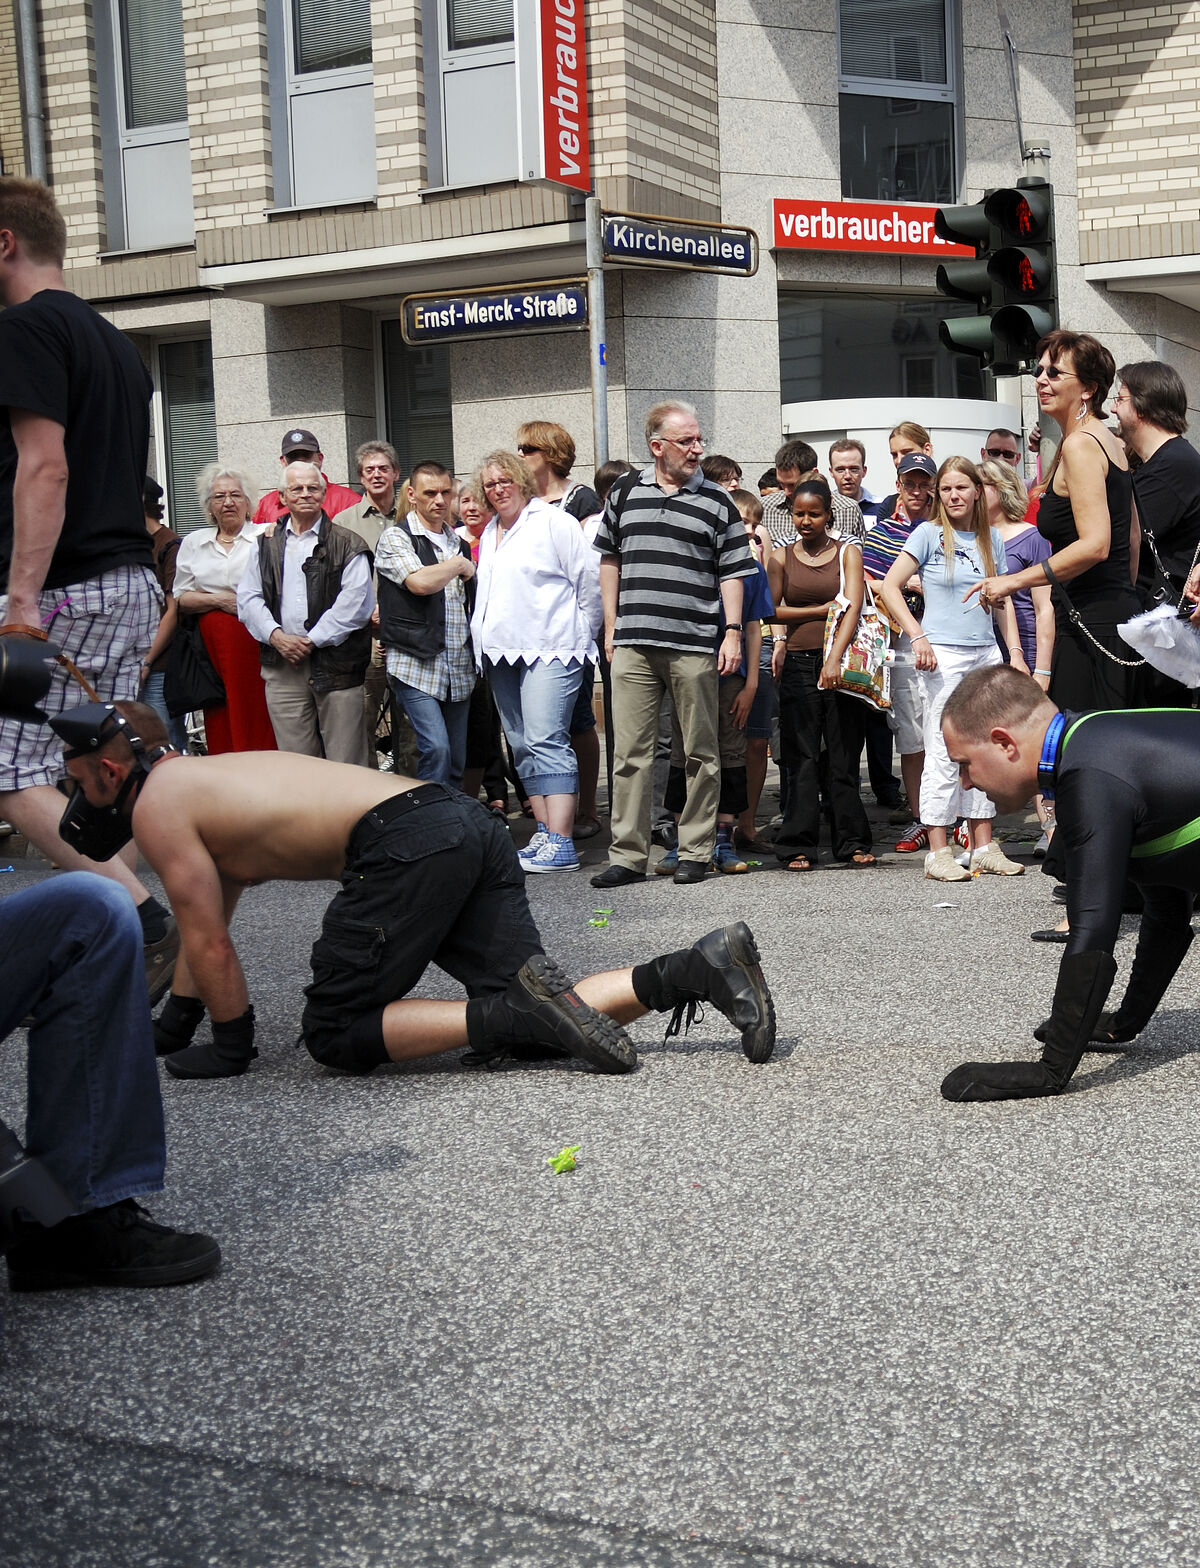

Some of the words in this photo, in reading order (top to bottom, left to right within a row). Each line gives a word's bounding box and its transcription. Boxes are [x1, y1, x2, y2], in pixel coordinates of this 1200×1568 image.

[550, 0, 581, 176] verbrauc
[613, 224, 746, 260] Kirchenallee
[779, 207, 956, 245] verbraucher
[414, 292, 577, 329] Ernst-Merck-Straße
